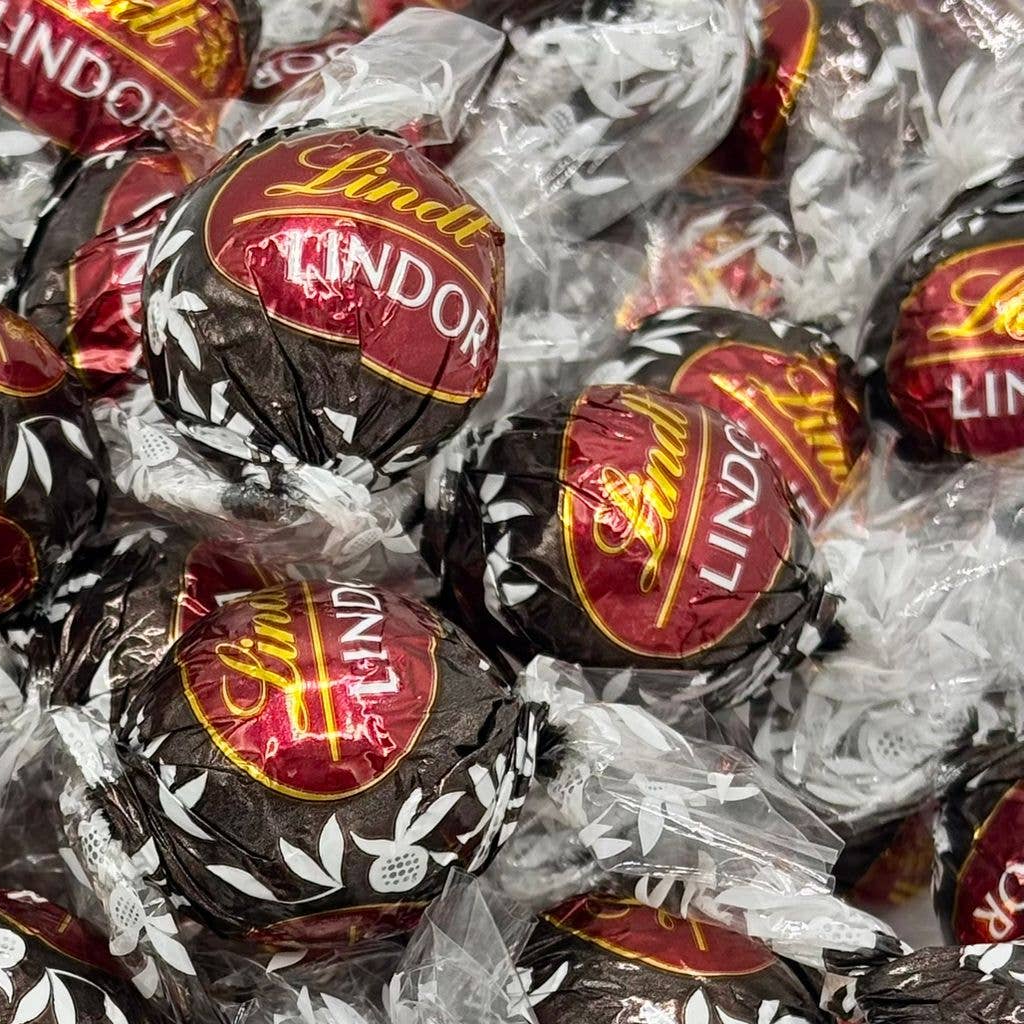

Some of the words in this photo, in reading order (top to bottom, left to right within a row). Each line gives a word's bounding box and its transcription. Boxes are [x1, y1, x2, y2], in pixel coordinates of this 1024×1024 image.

[263, 143, 491, 248] Lindt
[282, 227, 490, 368] LINDOR
[592, 389, 690, 594] Lindt
[698, 421, 764, 593] LINDO
